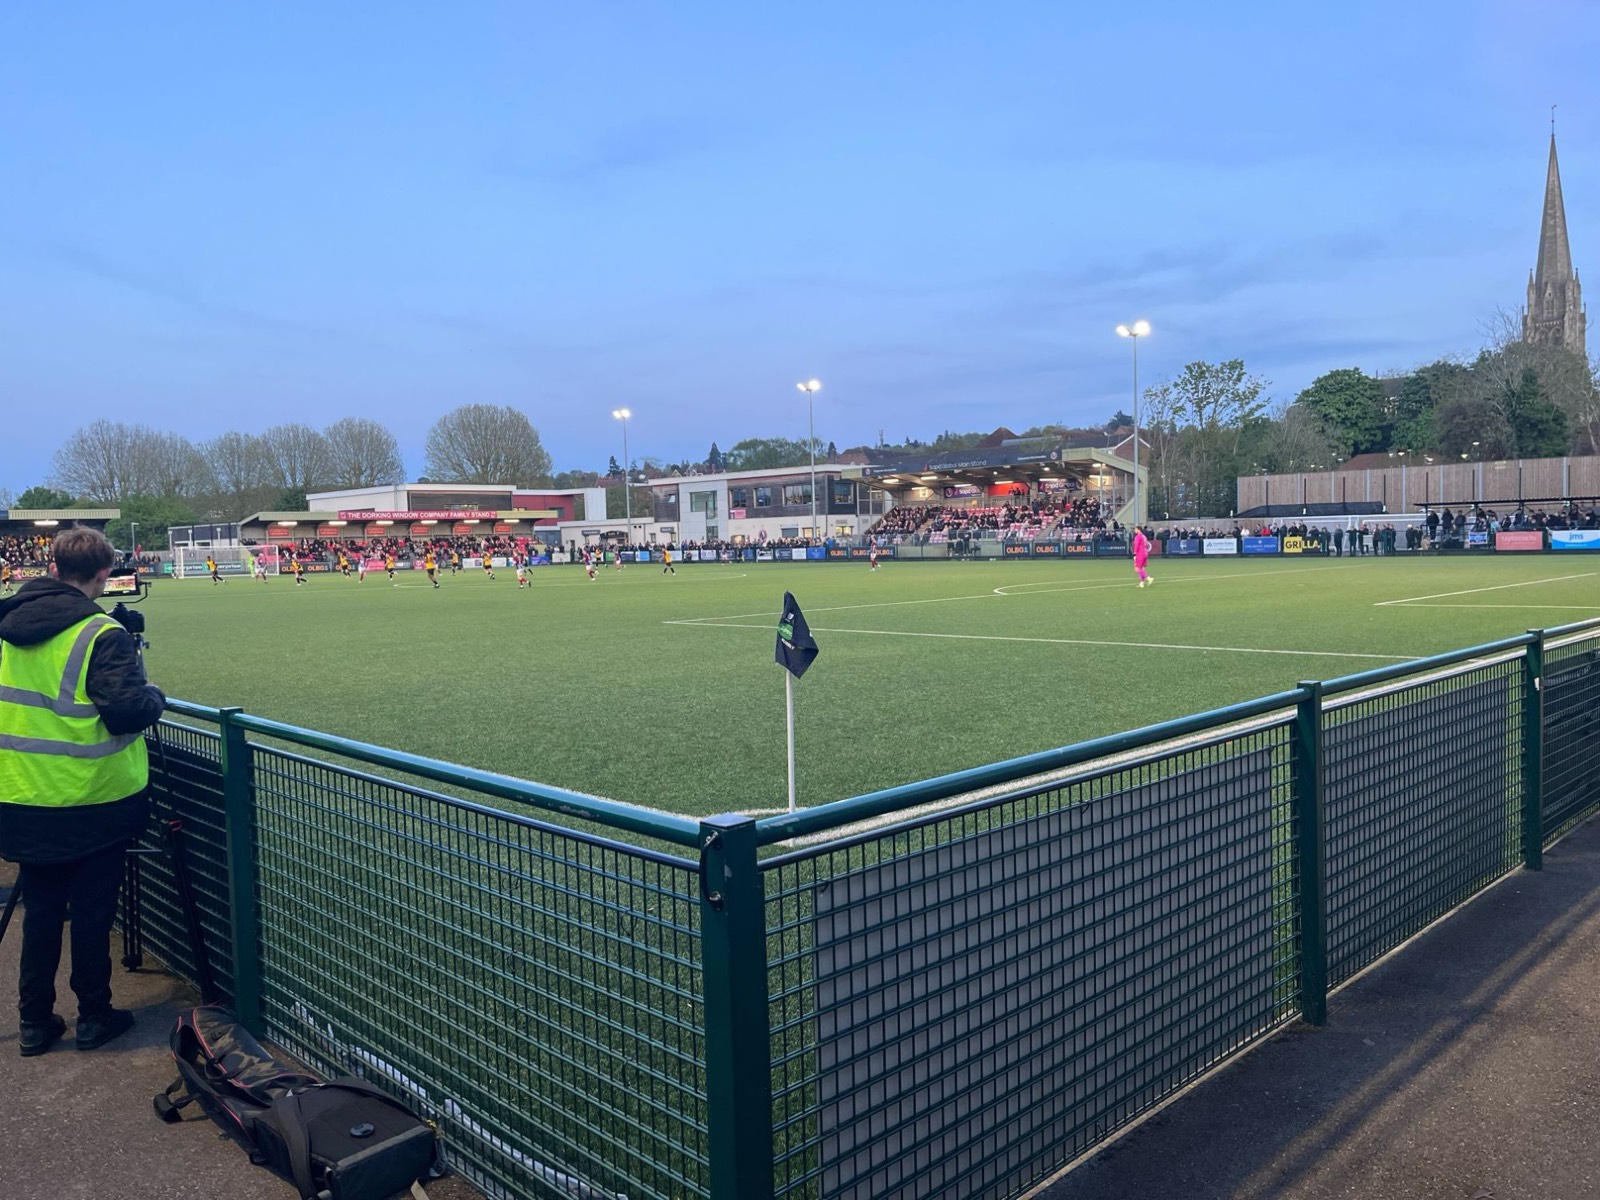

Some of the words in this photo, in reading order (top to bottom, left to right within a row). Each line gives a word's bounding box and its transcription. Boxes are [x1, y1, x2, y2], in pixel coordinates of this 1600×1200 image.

[392, 511, 419, 519] WINDOW
[449, 510, 470, 518] FAMILY
[470, 510, 490, 518] STAND
